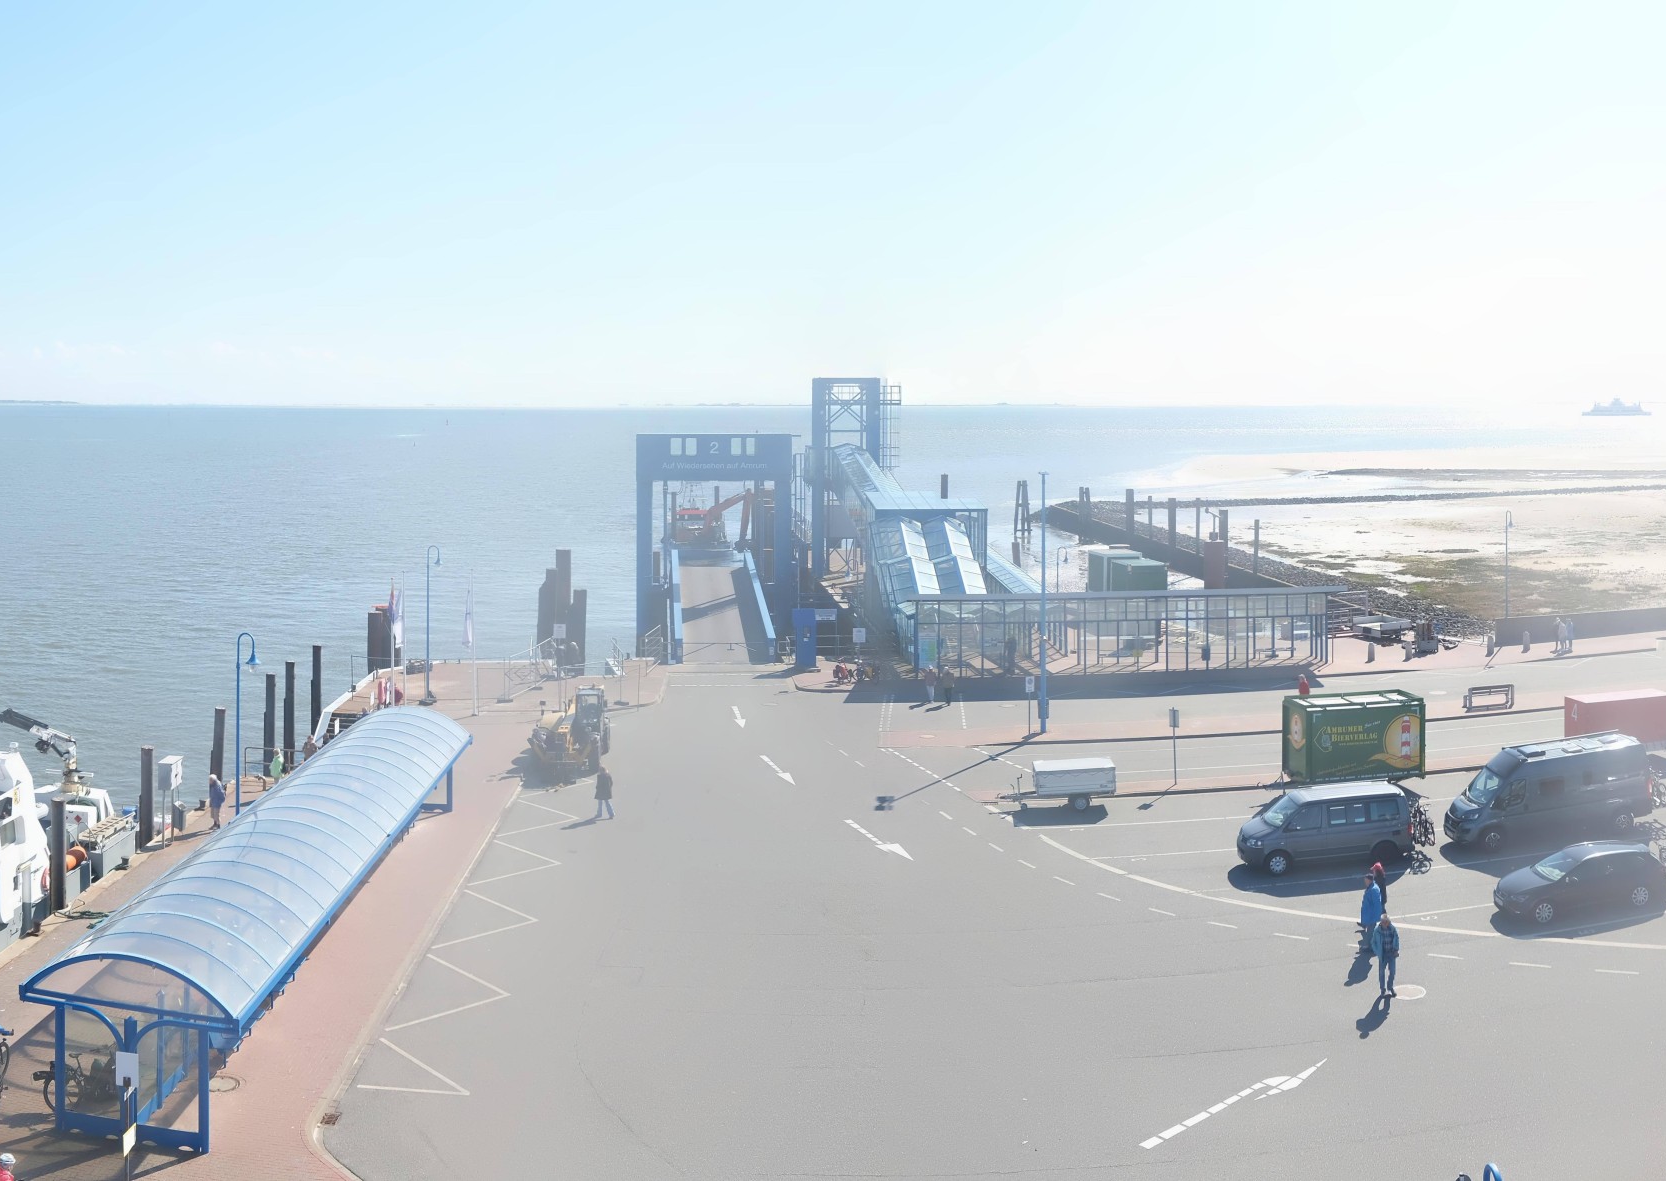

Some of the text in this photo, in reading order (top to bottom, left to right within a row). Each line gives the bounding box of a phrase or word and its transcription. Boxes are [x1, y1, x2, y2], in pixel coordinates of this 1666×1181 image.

[709, 441, 720, 454] 2
[662, 461, 768, 470] Auf Wiedersehen auf Amrum
[1571, 703, 1578, 721] 4
[1325, 725, 1363, 734] AMRUMER
[1331, 732, 1378, 742] BIERVERLAG
